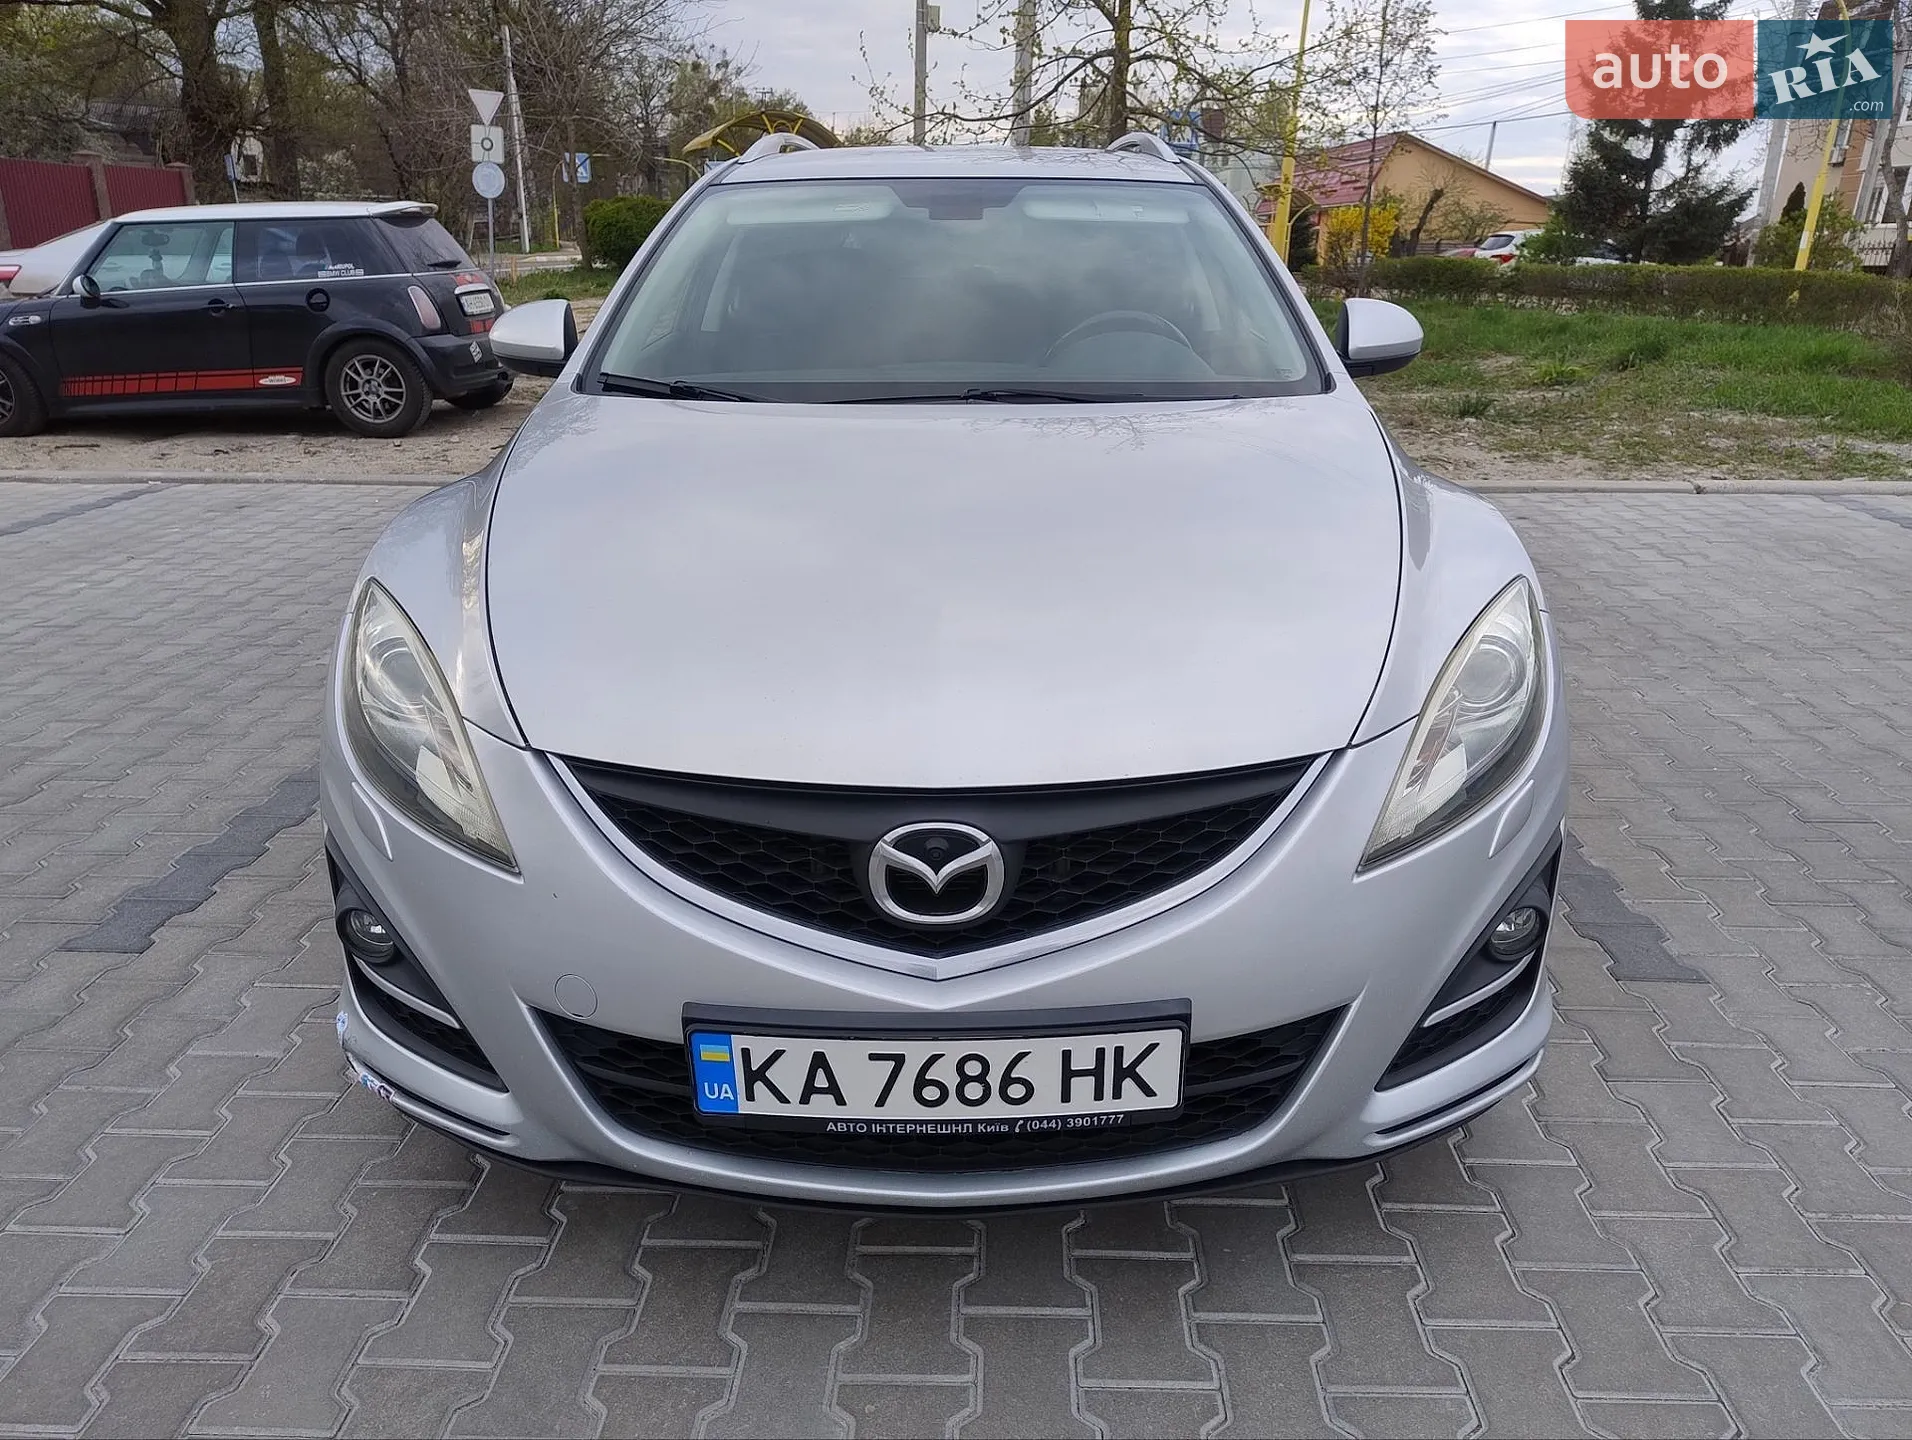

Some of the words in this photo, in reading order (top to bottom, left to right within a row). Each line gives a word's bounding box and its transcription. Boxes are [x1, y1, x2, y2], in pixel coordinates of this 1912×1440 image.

[740, 1047, 847, 1106] KA
[868, 1050, 1035, 1108] 7686
[1060, 1041, 1161, 1104] HK
[704, 1082, 734, 1100] UA
[826, 1121, 867, 1133] АВТО
[978, 1122, 1009, 1133] Київ
[1026, 1118, 1062, 1132] (044)
[1066, 1114, 1124, 1128] 3901777
